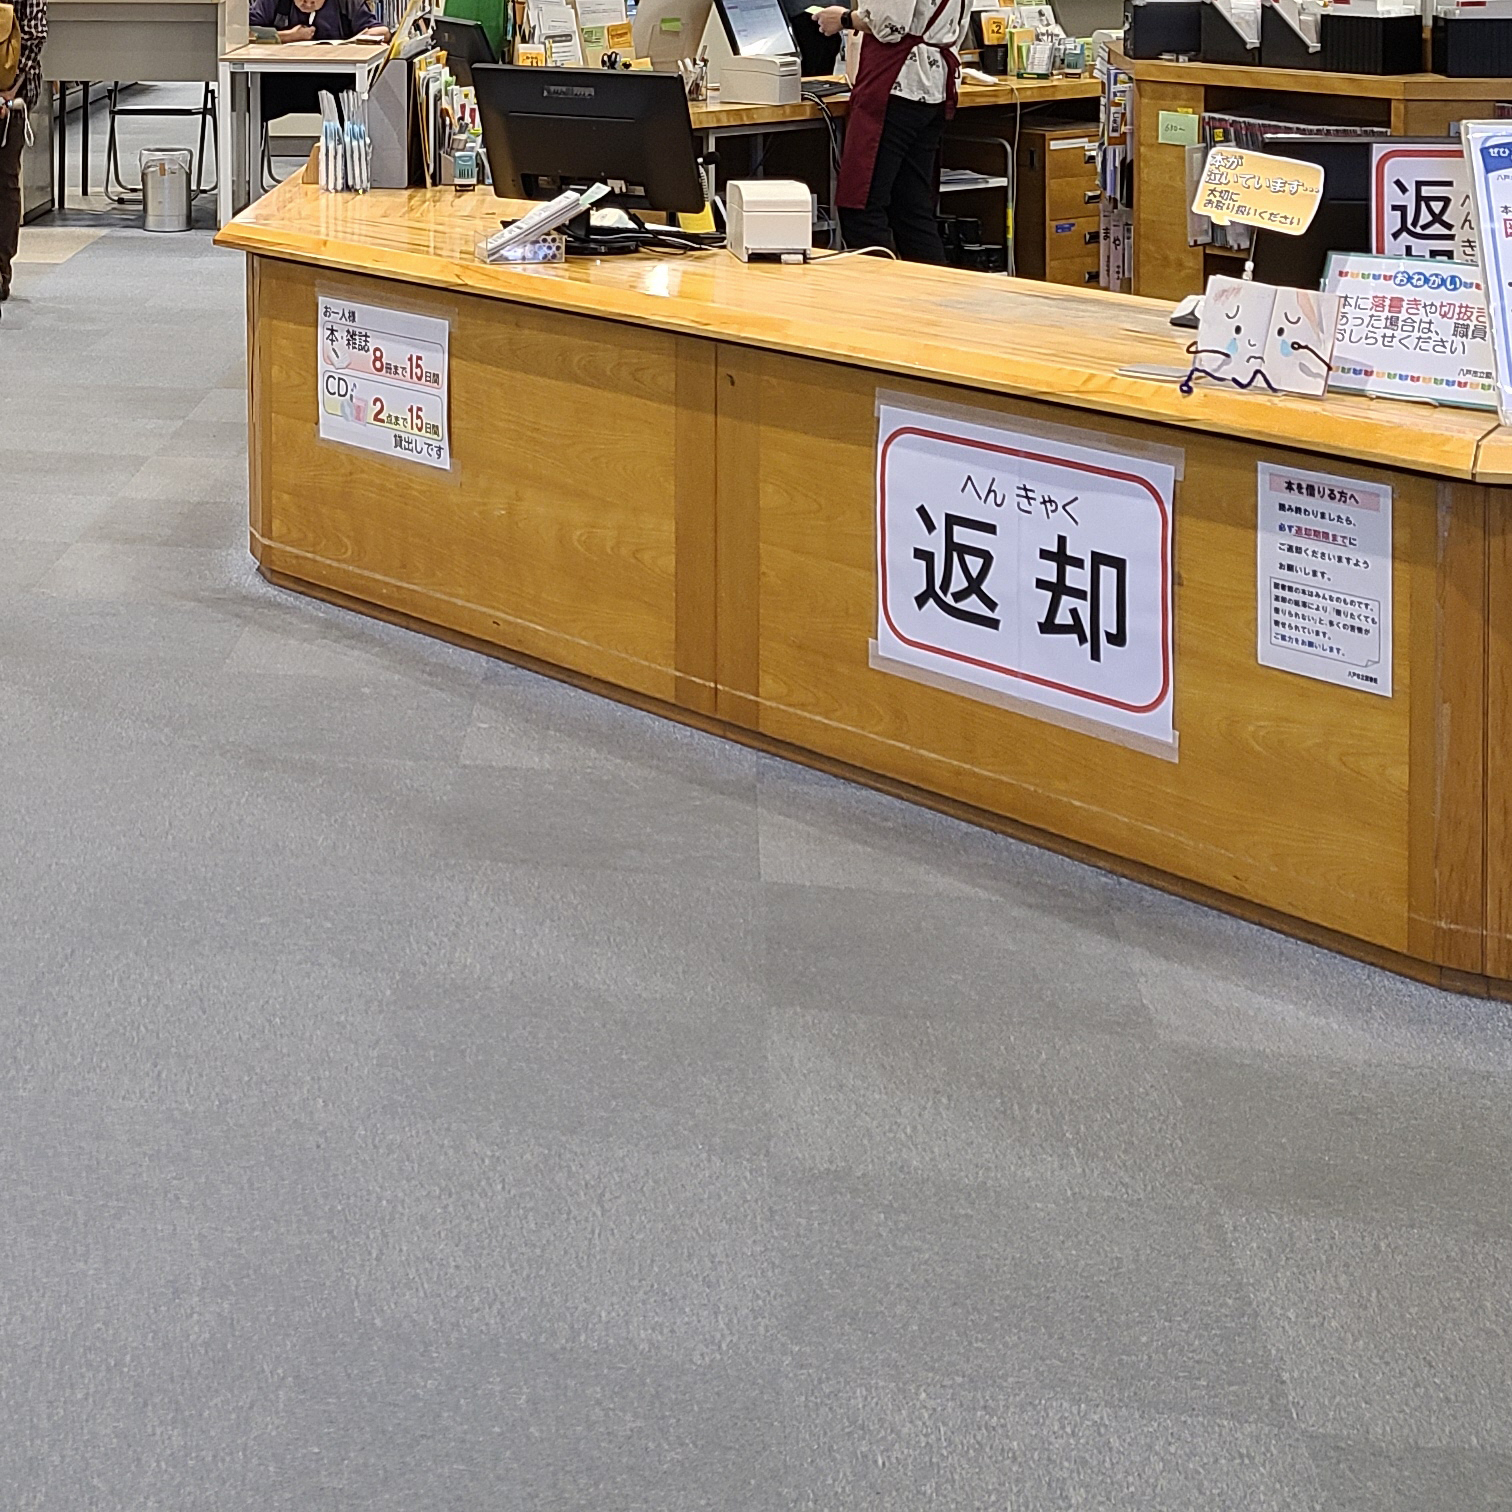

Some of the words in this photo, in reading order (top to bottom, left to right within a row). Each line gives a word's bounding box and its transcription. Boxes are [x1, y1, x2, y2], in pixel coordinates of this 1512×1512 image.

[1210, 152, 1244, 170] 本が
[1207, 187, 1241, 203] 大切に
[1393, 270, 1462, 290] おねがい
[325, 324, 371, 354] 本・雑誌
[325, 374, 349, 398] CD
[1457, 367, 1492, 380] 八戸市立図
[393, 433, 445, 461] 貸出しです
[1284, 480, 1360, 505] 本を借りる方へ
[1278, 502, 1357, 527] 読み終わりましたら、
[1278, 522, 1358, 547] 必ず返却期限までに
[1278, 542, 1371, 570] ご返却くださいますよう
[912, 503, 1128, 664] 返却
[1278, 561, 1332, 582] お願いします。
